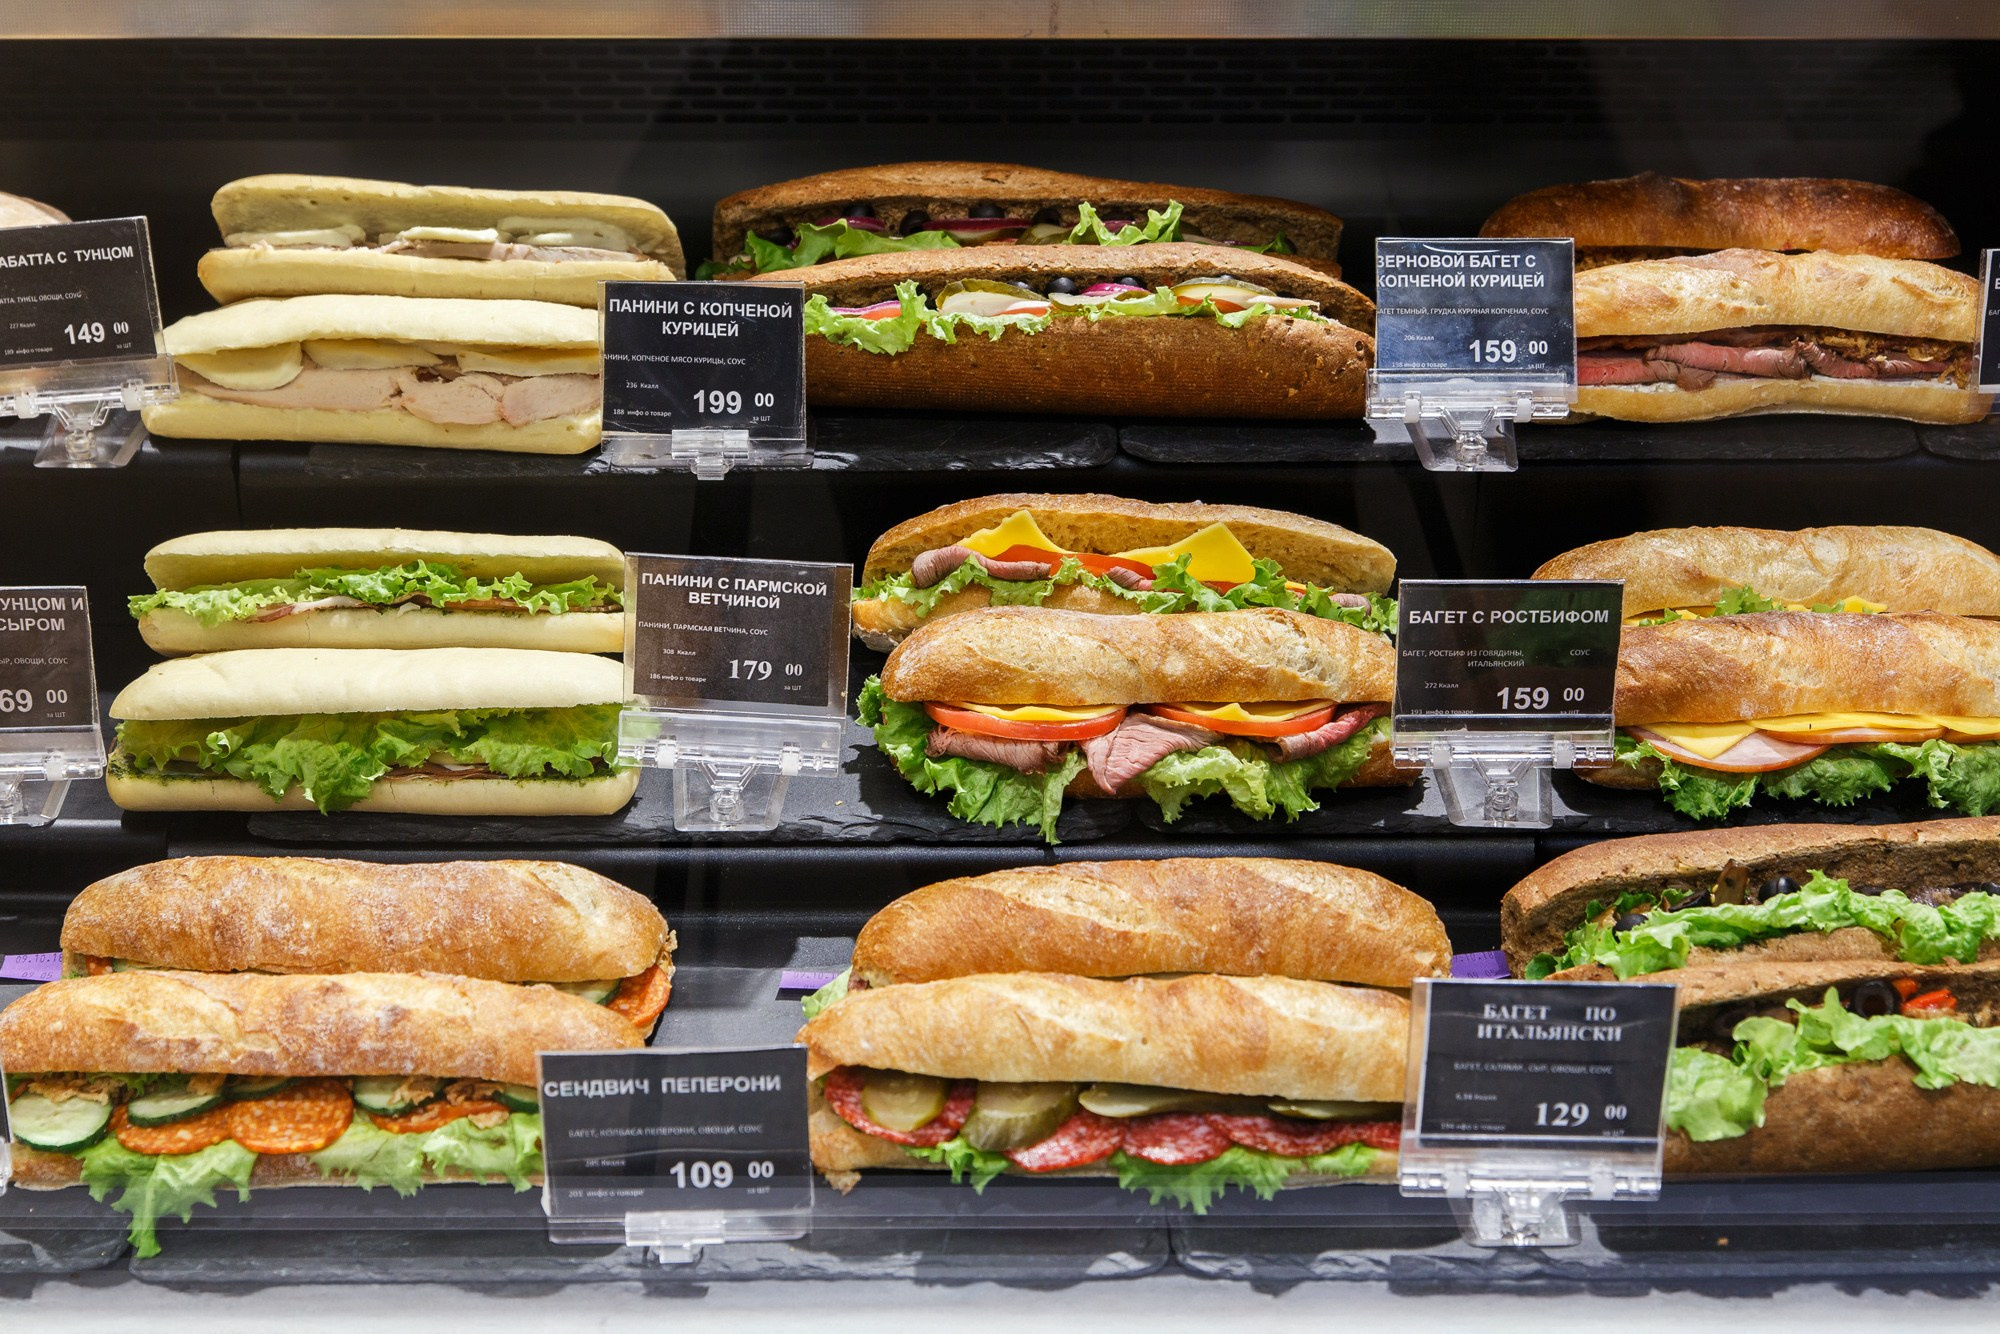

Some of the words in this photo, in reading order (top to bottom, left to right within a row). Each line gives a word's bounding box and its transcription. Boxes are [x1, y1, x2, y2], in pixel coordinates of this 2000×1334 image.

[0, 253, 54, 268] АБАТТА
[57, 252, 67, 264] С
[74, 246, 134, 261] ТУНЦОМ
[1377, 252, 1465, 268] ЗЕРНОВОЙ
[1470, 255, 1520, 268] БАГЕТ
[1525, 255, 1536, 268] С
[1377, 272, 1465, 288] КОПЧЕНОЙ
[1470, 272, 1544, 289] КУРИЦЕЙ
[609, 299, 678, 314] ПАНИНИ
[684, 302, 695, 315] С
[700, 303, 792, 318] КОПЧЕНОЙ
[1396, 307, 1429, 315] ТЕМНЫЙ,
[64, 322, 105, 345] 149
[113, 322, 129, 334] 00
[662, 321, 738, 339] КУРИЦЕЙ
[632, 355, 669, 363] КОПЧЕНОЕ
[694, 357, 725, 365] КУРИЦЫ,
[1469, 340, 1516, 363] 159
[1529, 341, 1548, 354] 00
[693, 390, 742, 414] 199
[755, 393, 775, 408] 00
[642, 573, 712, 588] ПАНИНИ
[718, 578, 729, 589] С
[735, 579, 827, 596] ПАРМСКОЙ
[0, 598, 65, 613] УНЦОМ
[72, 598, 84, 610] И
[689, 593, 780, 609] ВЕТЧИНОЙ
[0, 618, 65, 631] СЫРОМ
[1409, 611, 1467, 624] БАГЕТ
[1472, 611, 1484, 624] С
[1490, 610, 1609, 624] РОСТБИФОМ
[638, 622, 671, 630] ПАНИНИ,
[673, 624, 712, 632] ПАРМСКАЯ
[714, 626, 748, 635] ВЕТЧИНА,
[729, 660, 772, 680] 179
[785, 664, 802, 676] 00
[0, 689, 33, 713] 69
[46, 690, 68, 704] 00
[1497, 687, 1549, 710] 159
[1563, 687, 1585, 701] 00
[1484, 1004, 1550, 1020] БАГЕТ
[1585, 1007, 1616, 1022] ПО
[1477, 1024, 1622, 1042] ИТАЛЬЯНСКИ
[544, 1078, 649, 1098] СЕНДВИЧ
[661, 1075, 781, 1094] ПЕПЕРОНИ
[1535, 1102, 1589, 1127] 129
[1604, 1104, 1627, 1120] 00
[600, 1128, 643, 1136] КОЛБАСА
[670, 1161, 733, 1188] 109
[748, 1161, 774, 1178] 00
